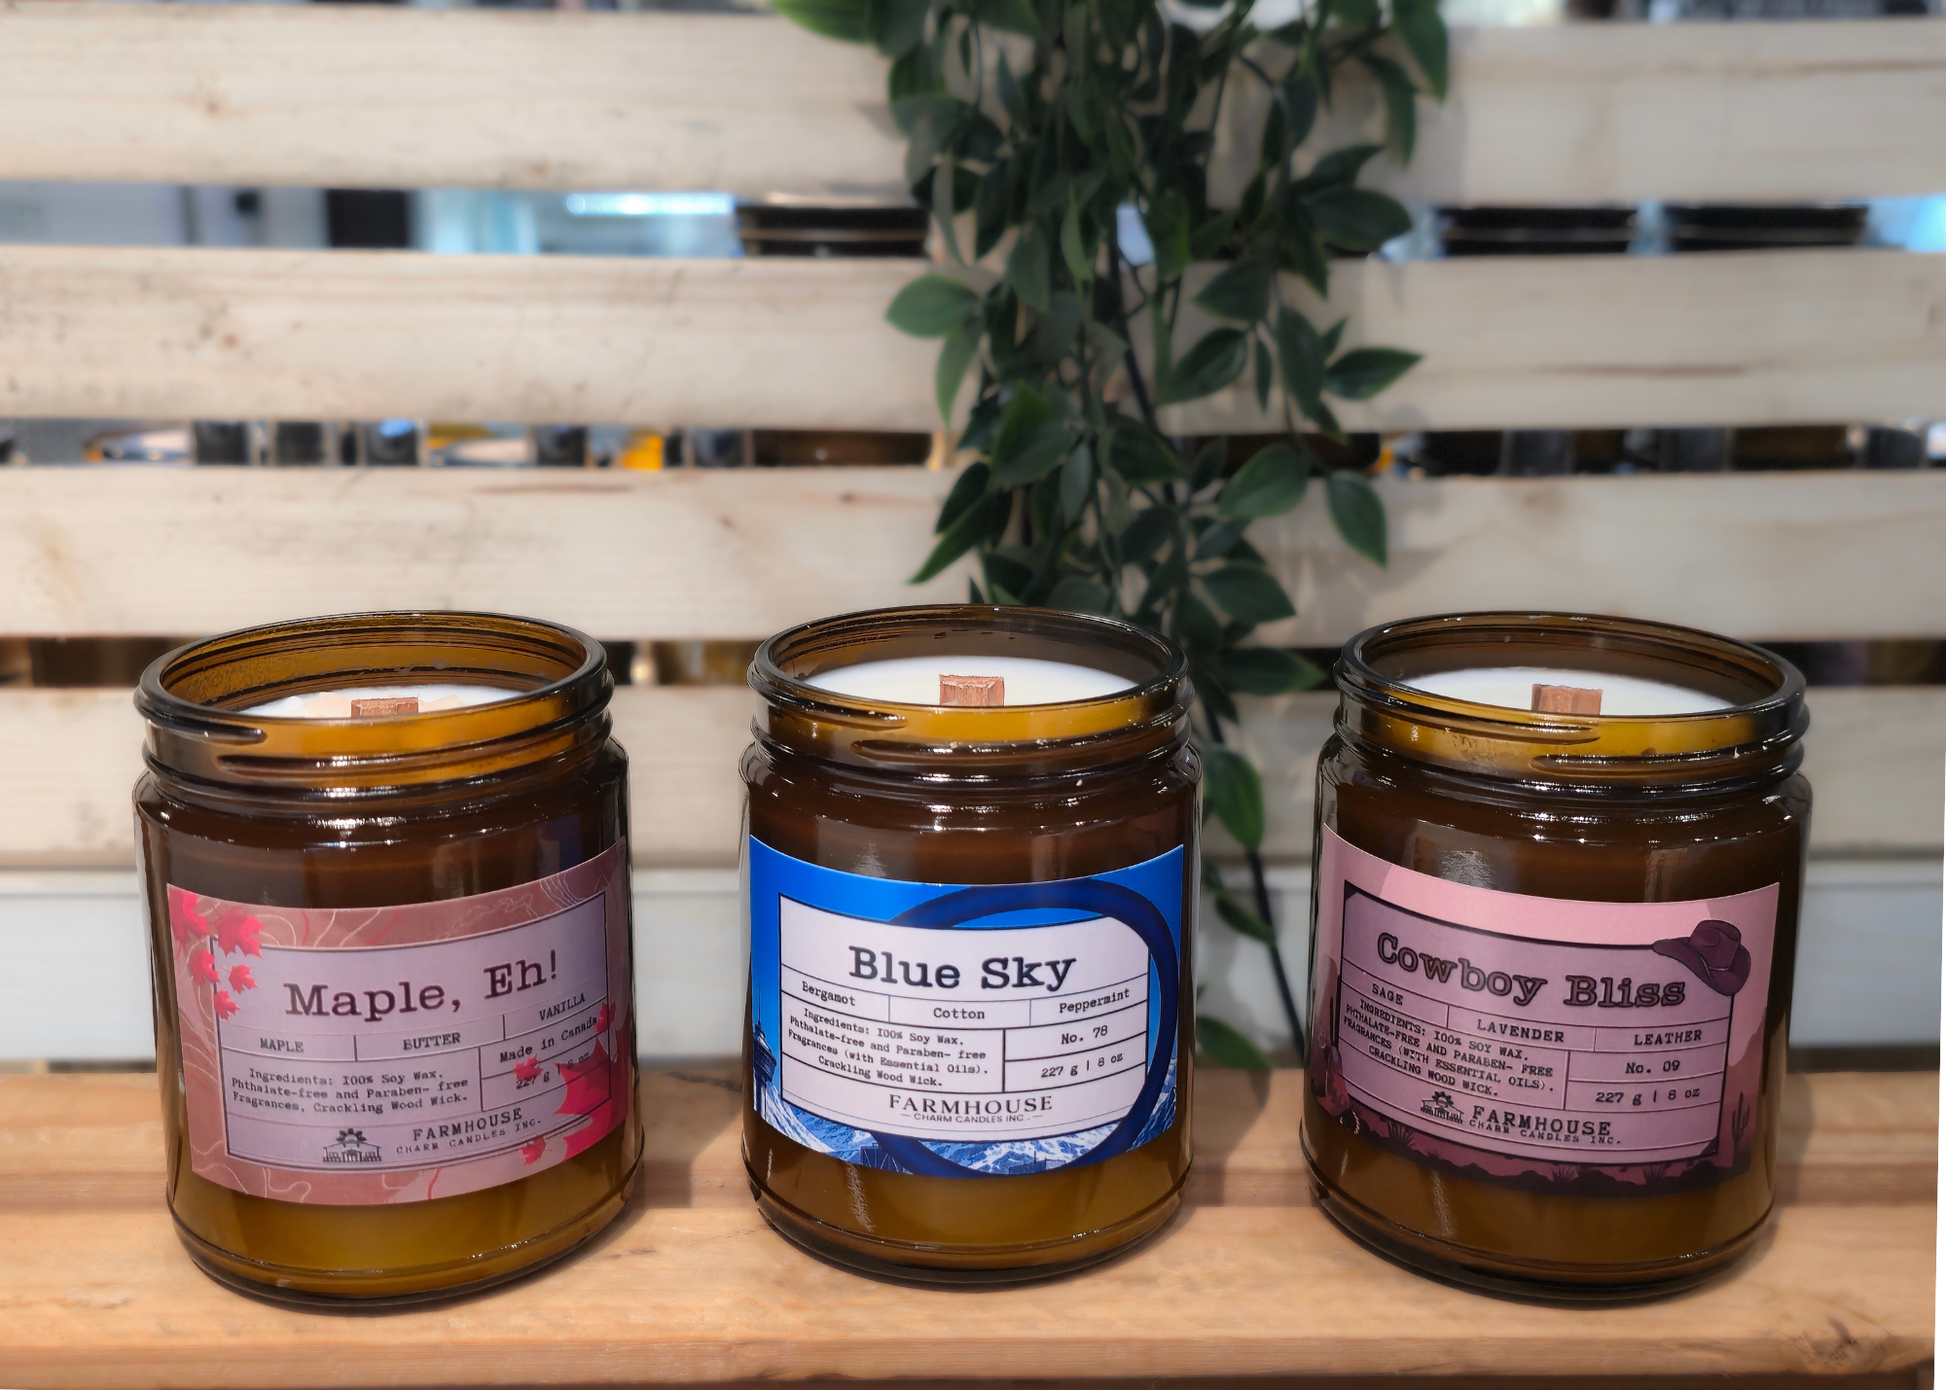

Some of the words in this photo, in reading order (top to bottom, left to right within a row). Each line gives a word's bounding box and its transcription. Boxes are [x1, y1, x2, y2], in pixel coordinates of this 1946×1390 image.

[848, 945, 960, 989] Blue
[980, 957, 1077, 992] Sky
[1376, 932, 1548, 1007] Cowboy
[1563, 974, 1686, 1008] Bliss
[284, 981, 461, 1022] Maple,
[484, 950, 558, 999] Eh!
[802, 980, 856, 1006] Bergamot
[1371, 983, 1404, 1006] SAGE
[539, 993, 586, 1021] VANILLA
[933, 1007, 985, 1019] Cotton
[1059, 988, 1130, 1013] Peppermint
[500, 1046, 533, 1063] Made
[541, 1037, 555, 1050] in
[561, 1016, 597, 1041] Canada
[790, 1015, 865, 1047] Phthalate-free
[870, 1041, 890, 1053] and
[896, 1045, 951, 1058] Paraben-
[958, 1050, 986, 1059] free
[803, 1008, 870, 1035] Ingredients:
[909, 1033, 930, 1046] Soy
[937, 1035, 964, 1046] Wax.
[1061, 1033, 1084, 1045] No.
[1092, 1025, 1108, 1039] 78
[1360, 998, 1426, 1036] INGREDIENTS:
[1468, 1040, 1492, 1054] SOY
[1499, 1046, 1529, 1061] WAX.
[1477, 1019, 1565, 1043] LAVENDER
[1633, 1030, 1702, 1046] LEATHER
[260, 1037, 304, 1053] MAPLE
[403, 1032, 461, 1051] BUTTER
[788, 1030, 838, 1055] Fragrances
[844, 1050, 874, 1064] (with
[880, 1056, 940, 1073] Essential
[947, 1064, 988, 1075] Oils).
[1346, 1004, 1421, 1048] PHTHALATE-FREE
[1426, 1043, 1447, 1056] AND
[1453, 1047, 1513, 1070] PARABEN-
[1521, 1064, 1554, 1077] FREE
[1041, 1066, 1064, 1078] 227
[1070, 1065, 1078, 1076] g
[1097, 1057, 1105, 1067] 8
[1110, 1053, 1124, 1063] oz
[1344, 1016, 1392, 1049] FRAGRANCES
[1398, 1044, 1429, 1064] (WITH
[1435, 1059, 1501, 1083] ESSENTIAL
[1508, 1076, 1554, 1092] OILS).
[1625, 1062, 1652, 1074] No.
[1663, 1060, 1681, 1072] 09
[249, 1068, 333, 1086] Ingredients:
[381, 1074, 405, 1085] Soy
[413, 1070, 443, 1080] Wax.
[818, 1055, 871, 1080] Crackling
[876, 1069, 903, 1083] Wood
[909, 1075, 943, 1086] Wick.
[1368, 1045, 1422, 1075] CRACKLING
[1428, 1070, 1456, 1086] WOOD
[1462, 1080, 1498, 1096] WICK.
[231, 1078, 328, 1099] Phthalate-free
[336, 1089, 359, 1099] and
[367, 1086, 429, 1099] Paraben-
[437, 1079, 469, 1092] free
[1595, 1092, 1624, 1103] 227
[1632, 1094, 1642, 1106] g
[1668, 1089, 1677, 1100] 8
[1684, 1088, 1700, 1098] oz
[233, 1091, 305, 1112] Fragrances,
[314, 1102, 384, 1114] Crackling
[391, 1099, 423, 1110] Wood
[430, 1094, 468, 1106] Wick.
[889, 1094, 1053, 1115] FARMHOUSE
[412, 1107, 523, 1141] FARMHOUSE
[914, 1112, 952, 1123] CHARM
[955, 1115, 1003, 1124] CANDLES
[1472, 1105, 1612, 1136] FARMHOUSE
[396, 1142, 439, 1154] CHARM
[449, 1128, 506, 1147] CANDLES
[515, 1118, 541, 1132] INC.
[1469, 1119, 1510, 1135] CHARM
[1520, 1129, 1580, 1143] CANDLES
[1590, 1136, 1622, 1145] INC.
